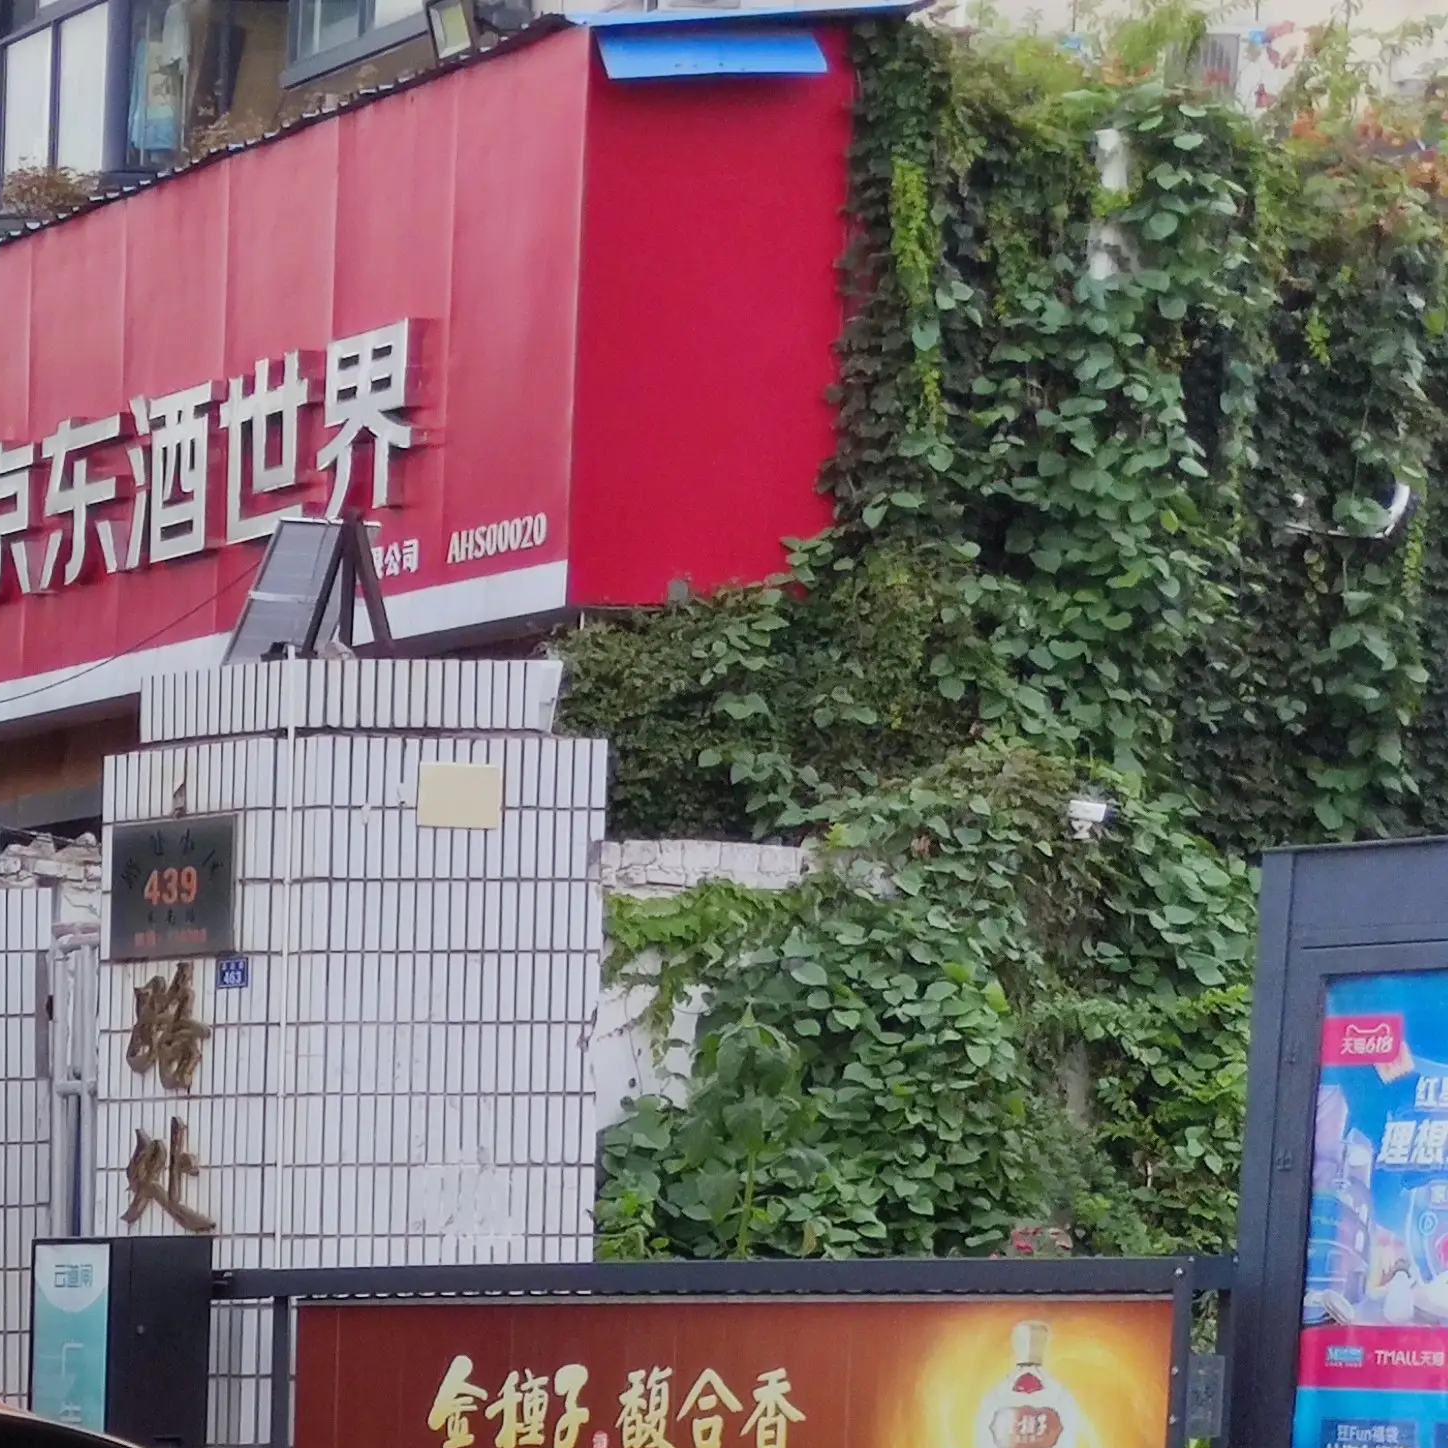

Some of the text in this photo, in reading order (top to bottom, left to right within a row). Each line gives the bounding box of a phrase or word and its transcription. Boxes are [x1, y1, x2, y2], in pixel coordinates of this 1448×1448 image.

[446, 511, 547, 565] AHS00020
[143, 865, 199, 905] 439
[1375, 1112, 1448, 1166] 理想
